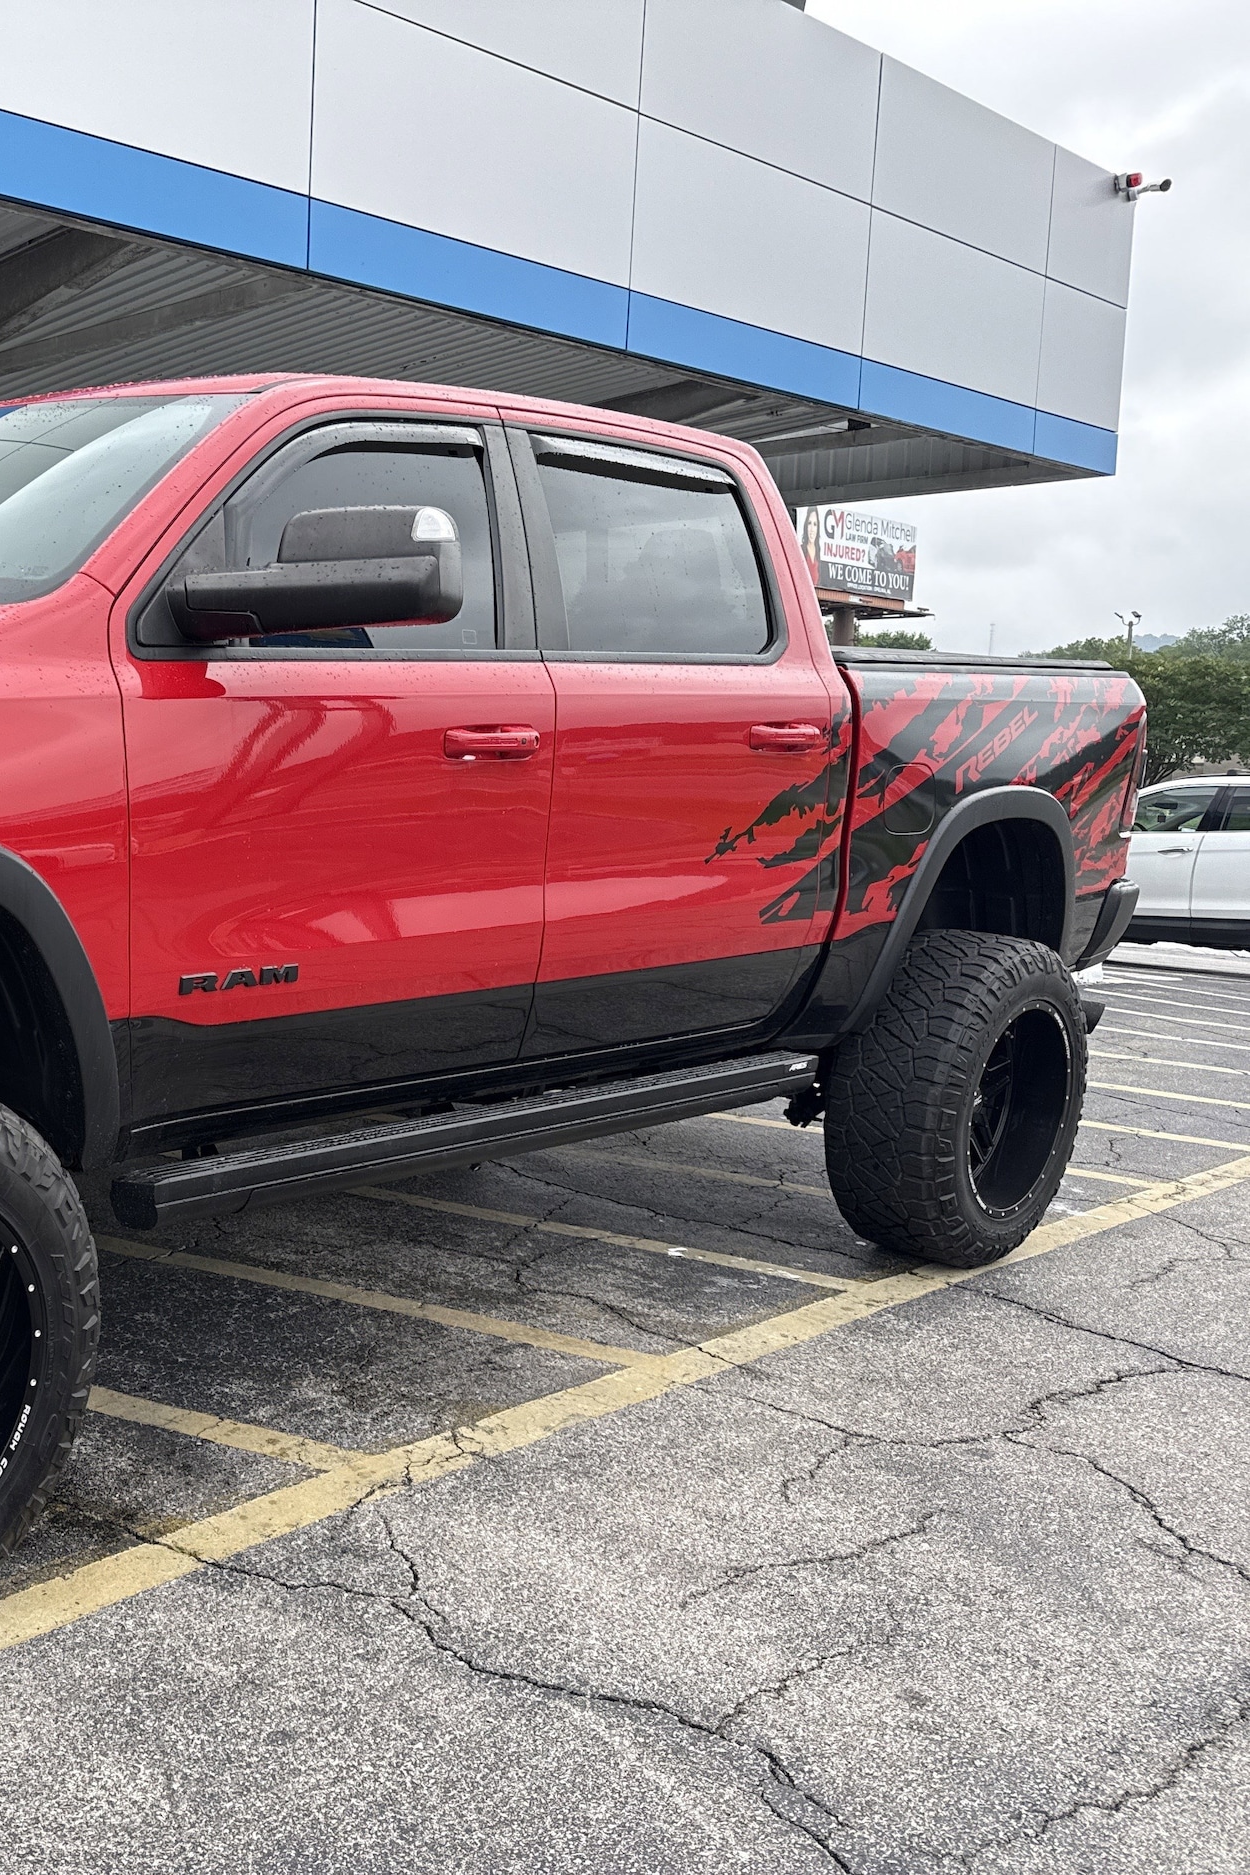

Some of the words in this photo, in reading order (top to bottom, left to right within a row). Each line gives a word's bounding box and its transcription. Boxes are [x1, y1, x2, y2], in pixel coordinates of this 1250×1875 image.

[845, 512, 878, 536] Glenda
[881, 519, 917, 543] Mitchell
[823, 541, 866, 563] INJURED?
[828, 562, 844, 580] WE
[845, 565, 872, 585] COME
[874, 570, 887, 587] TO
[888, 572, 910, 591] YOU!
[955, 705, 1038, 794] REBEL
[178, 963, 299, 996] RAM
[9, 1404, 31, 1451] ROUGH
